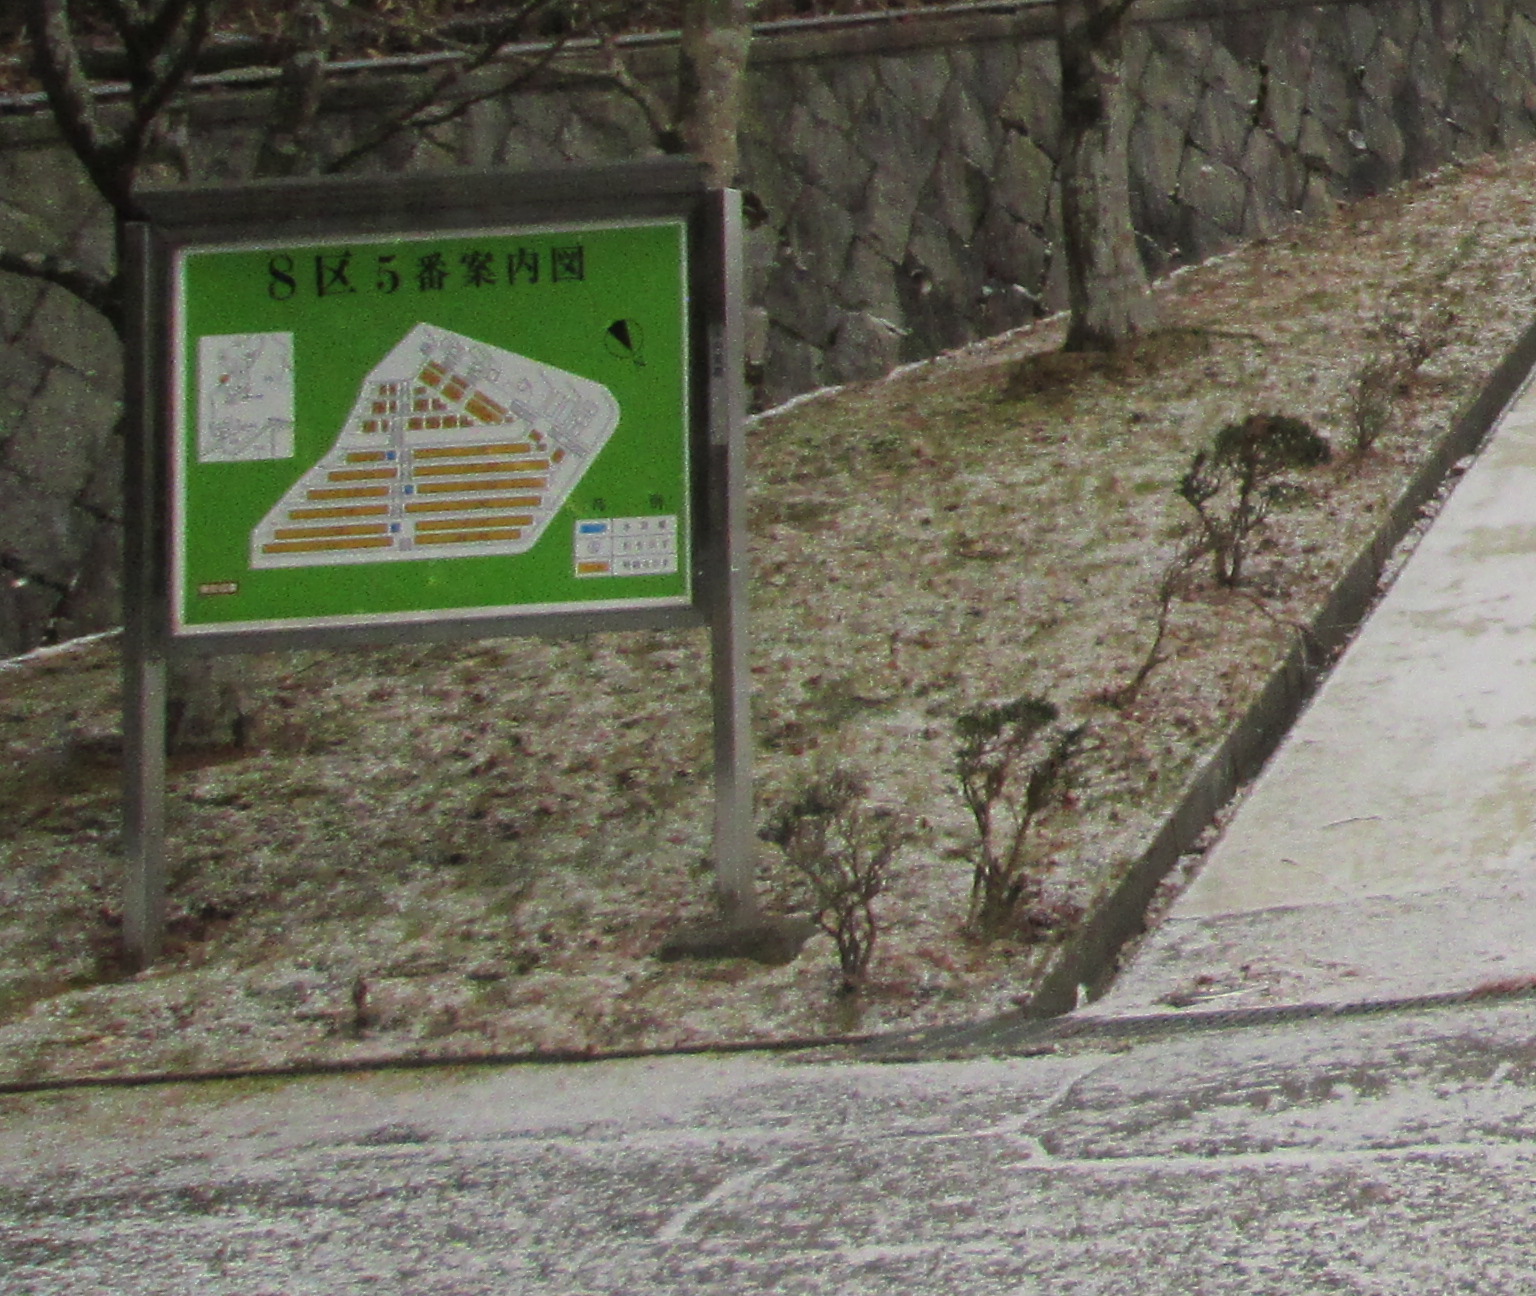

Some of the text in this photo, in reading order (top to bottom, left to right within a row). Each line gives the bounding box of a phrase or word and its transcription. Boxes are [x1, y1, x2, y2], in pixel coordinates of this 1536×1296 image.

[267, 244, 585, 301] 8区5番案内図
